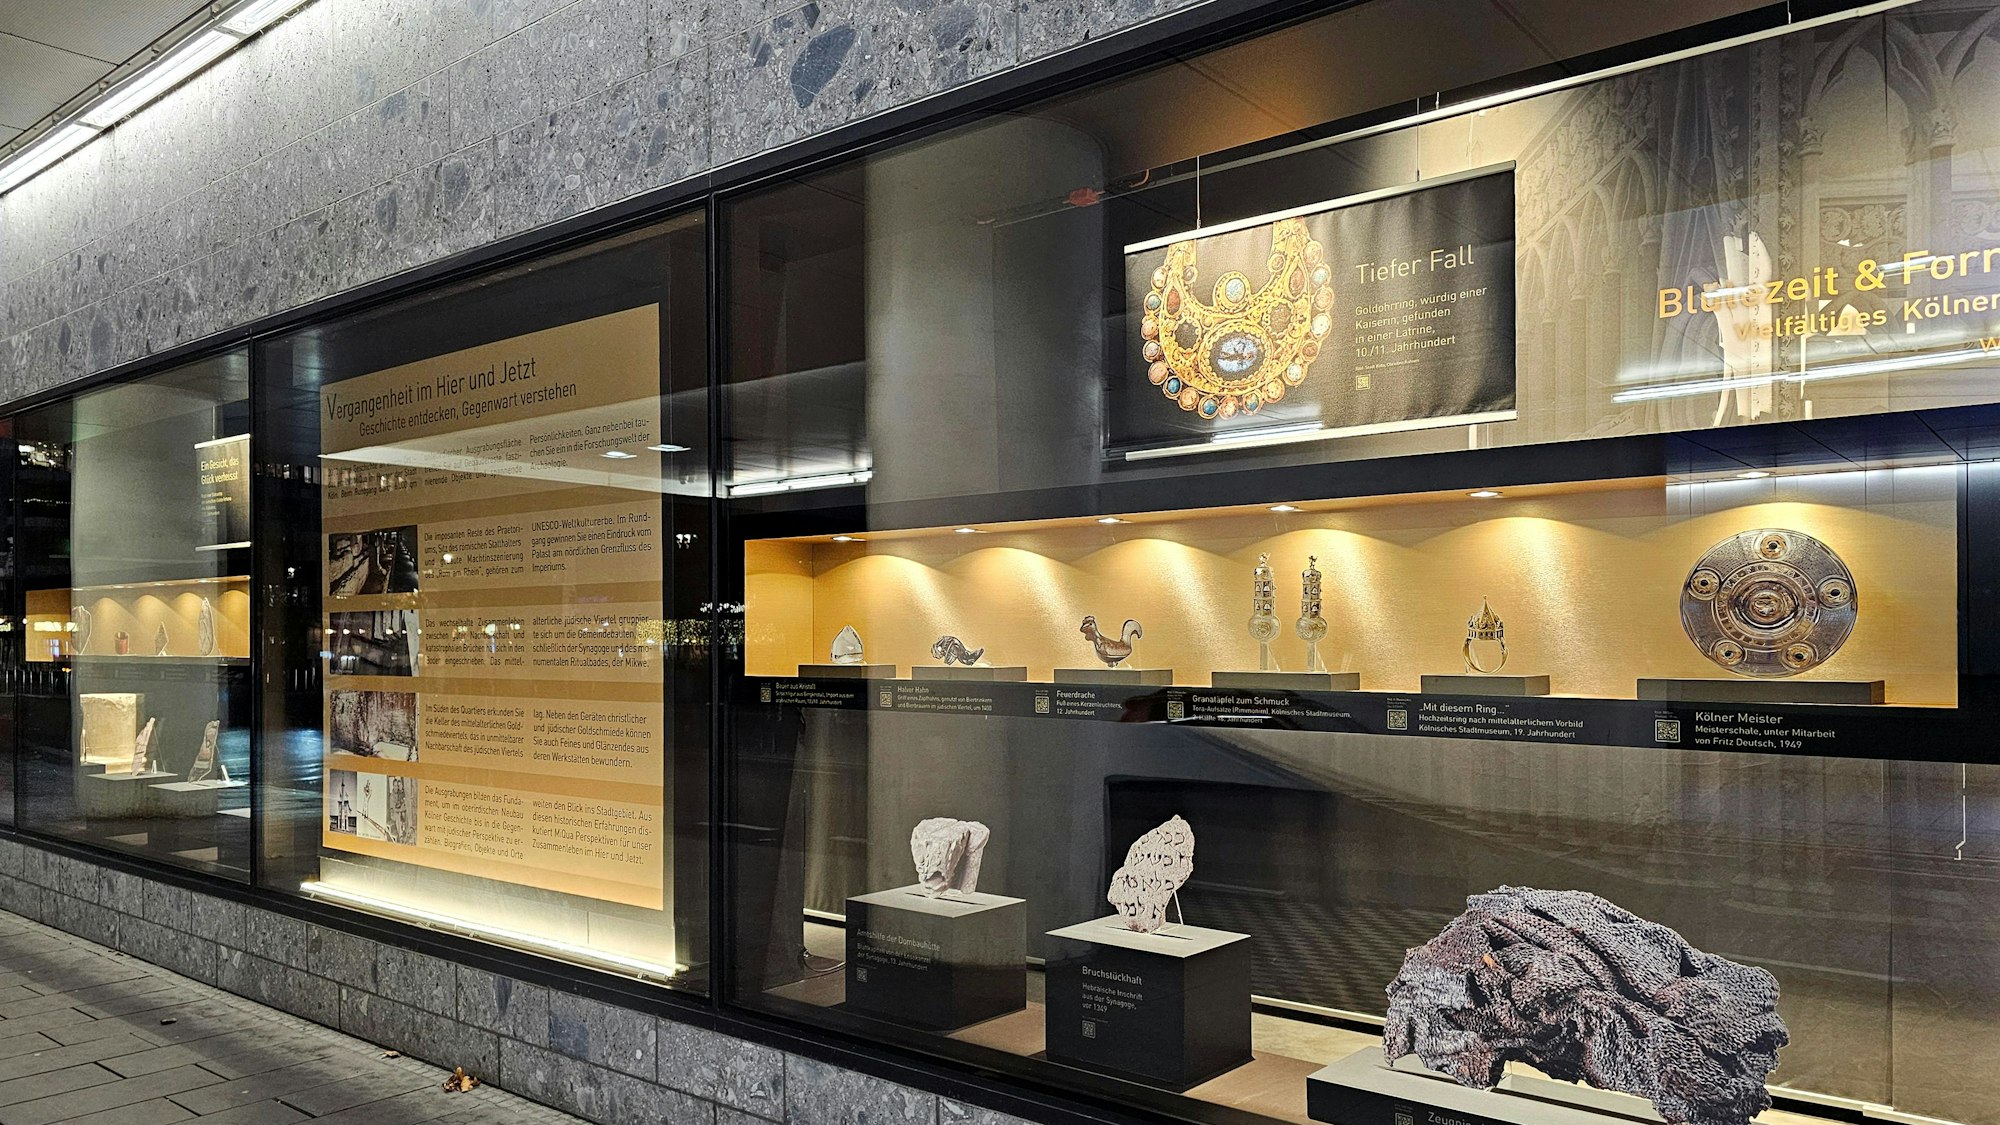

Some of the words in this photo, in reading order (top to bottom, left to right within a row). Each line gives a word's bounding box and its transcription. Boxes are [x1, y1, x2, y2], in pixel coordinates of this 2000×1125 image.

[1356, 258, 1422, 284] Tiefer
[1430, 244, 1474, 271] Fall
[1854, 259, 1887, 291] &
[1355, 299, 1417, 315] Goldohrring,
[1459, 287, 1487, 299] einer
[1402, 308, 1451, 325] gefunden
[1355, 335, 1364, 344] in
[1368, 331, 1393, 342] einer
[1396, 325, 1435, 338] Latrine,
[1392, 335, 1455, 353] Jahrhundert
[327, 384, 413, 422] Vergangenheit
[417, 382, 432, 402] im
[437, 375, 465, 398] Hier
[469, 364, 495, 390] und
[500, 357, 536, 384] Jetzt
[360, 416, 406, 437] Geschichte
[409, 407, 459, 428] entdecken,
[462, 392, 517, 418] Gegenwart
[521, 383, 577, 405] verstehen
[585, 426, 601, 435] Ganz
[603, 419, 634, 432] nebenbei
[530, 446, 545, 457] chen
[546, 445, 555, 455] Sie
[556, 444, 565, 453] ein
[567, 443, 573, 452] in
[574, 442, 583, 451] die
[584, 433, 637, 450] Forschungswelt
[638, 432, 650, 442] der
[201, 461, 209, 471] Ein
[229, 457, 239, 466] das
[617, 514, 626, 524] Im
[629, 512, 651, 523] Rund-
[532, 538, 545, 547] gang
[547, 534, 576, 546] gewinnen
[577, 531, 587, 542] Sie
[588, 530, 605, 540] einen
[607, 528, 635, 539] Eindruck
[636, 528, 651, 537] vom
[532, 549, 550, 559] Palast
[565, 546, 598, 556] nördlichen
[601, 543, 636, 554] Grenzfluss
[638, 542, 651, 551] des
[532, 562, 567, 573] Imperiums.
[567, 643, 578, 652] der
[579, 643, 610, 655] Synagoge
[533, 658, 569, 667] numentalen
[612, 658, 624, 667] der
[625, 658, 649, 667] Mikwe.
[1056, 690, 1095, 699] Feuerdrache
[1192, 694, 1235, 704] Granatäpfel
[1254, 697, 1289, 706] Schmuck
[1271, 708, 1305, 716] Kölnisches
[1440, 703, 1473, 713] diesem
[533, 709, 544, 721] lag.
[546, 710, 566, 720] Neben
[567, 710, 579, 720] den
[580, 711, 606, 722] Geräten
[607, 712, 647, 724] christlicher
[1419, 714, 1467, 724] Hochzeitsring
[1468, 716, 1487, 724] nach
[1488, 717, 1554, 726] mittelalterlichem
[1555, 720, 1583, 728] Vorbild
[1695, 711, 1734, 722] Kölner
[1738, 713, 1783, 724] Meister
[533, 723, 545, 732] und
[547, 723, 576, 734] jüdischer
[578, 725, 624, 737] Goldschmiede
[626, 728, 651, 739] können
[1419, 724, 1457, 733] Kölnisches
[1458, 726, 1512, 736] Stadtmuseum,
[1527, 729, 1575, 738] Jahrhundert
[1695, 724, 1762, 736] Meisterschale,
[1764, 728, 1789, 736] unter
[1792, 728, 1835, 738] Mitarbeit
[533, 736, 542, 746] Sie
[544, 737, 559, 747] auch
[560, 738, 581, 748] Feines
[583, 740, 594, 749] und
[595, 740, 634, 752] Glänzendes
[636, 745, 649, 753] aus
[1713, 737, 1734, 746] Fritz
[1736, 738, 1776, 748] Deutsch,
[1780, 740, 1801, 748] 1949
[533, 751, 550, 760] deren
[552, 752, 589, 763] Werkstätten
[591, 756, 633, 767] bewundern.
[533, 799, 552, 809] weiten
[554, 801, 566, 811] den
[567, 802, 583, 812] Blick
[585, 804, 595, 814] ins
[597, 805, 637, 820] Stadtgebiet.
[639, 810, 652, 821] Aus
[533, 812, 552, 823] diesen
[554, 814, 592, 828] historischen
[594, 819, 636, 835] Erfahrungen
[639, 826, 652, 836] dis-
[532, 826, 552, 837] kutiert
[575, 831, 618, 846] Perspektiven
[620, 837, 630, 848] für
[632, 841, 652, 851] unser
[532, 839, 583, 855] Zusammenleben
[584, 847, 593, 857] im
[595, 848, 609, 858] Hier
[611, 852, 623, 861] und
[625, 852, 644, 865] Jetzt.
[886, 934, 897, 942] der
[1082, 965, 1142, 986] Bruchstückhaft
